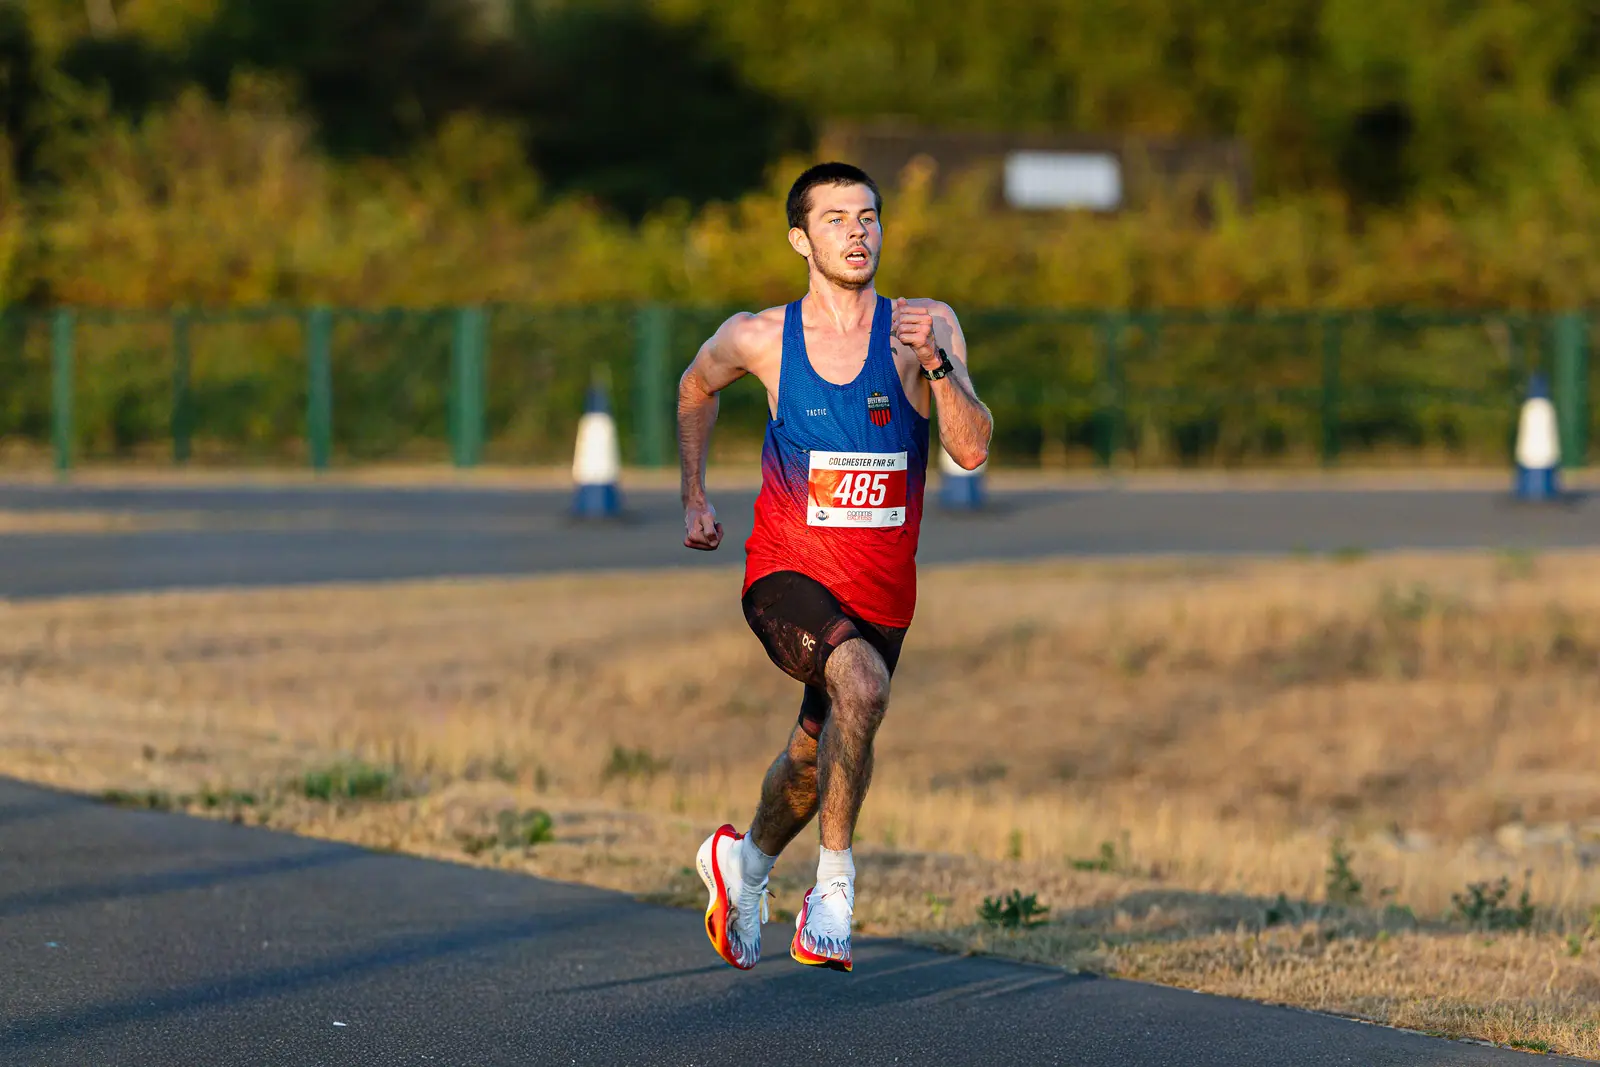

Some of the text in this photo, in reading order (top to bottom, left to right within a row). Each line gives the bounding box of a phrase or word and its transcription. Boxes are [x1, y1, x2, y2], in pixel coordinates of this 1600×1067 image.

[806, 408, 827, 416] TACTIC
[829, 457, 896, 467] COLCHESTER FNR 5K
[833, 473, 889, 506] 485
